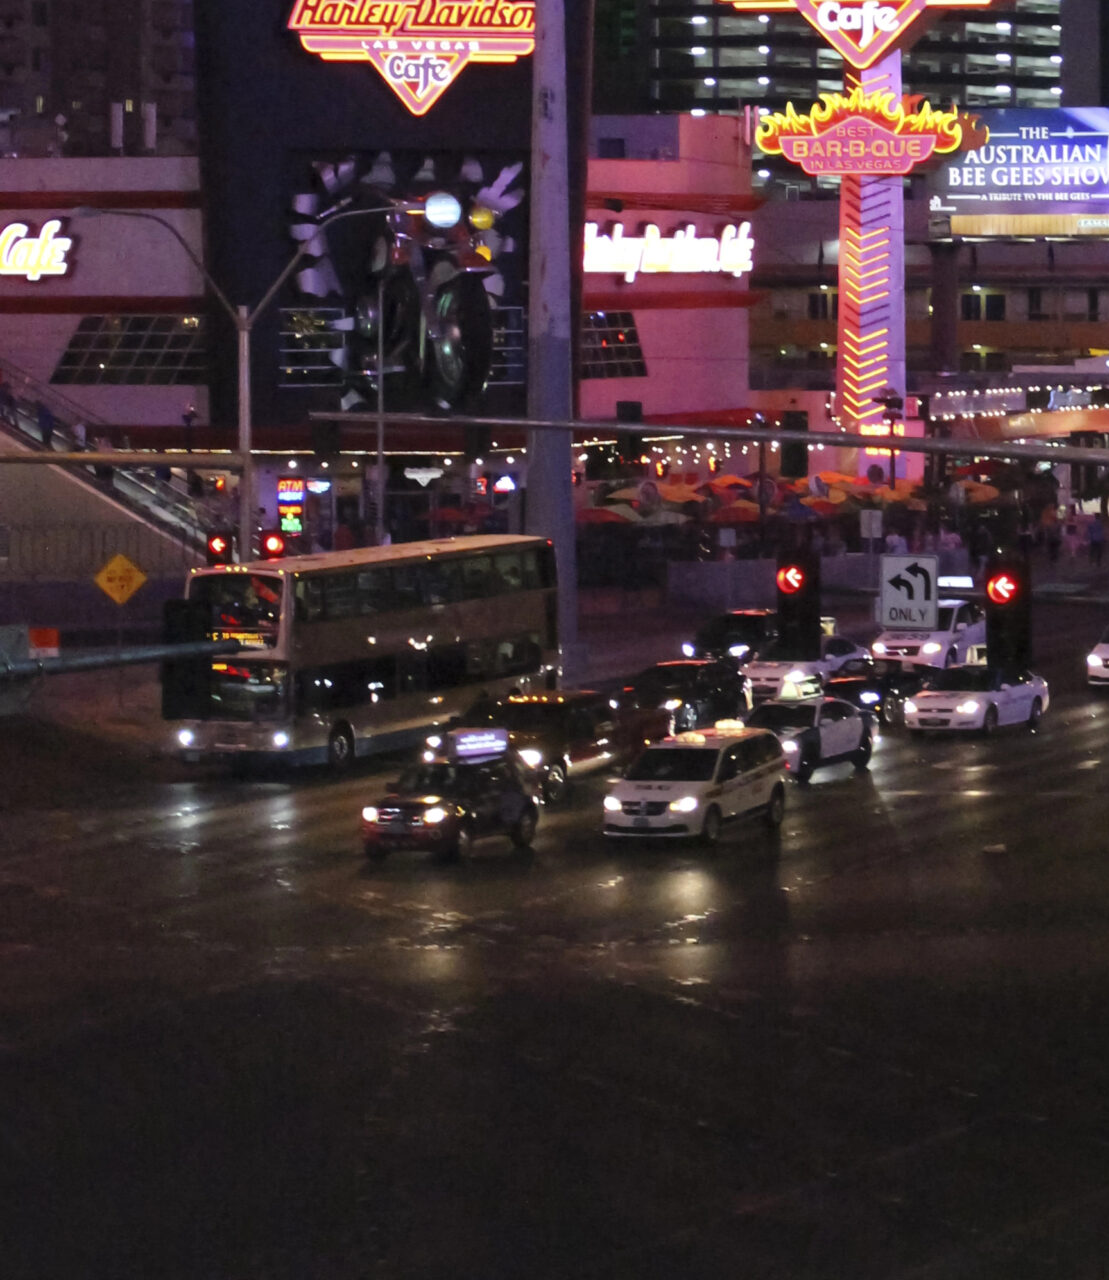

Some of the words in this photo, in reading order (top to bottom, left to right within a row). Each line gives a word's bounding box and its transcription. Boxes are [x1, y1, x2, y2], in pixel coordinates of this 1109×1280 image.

[360, 40, 398, 51] LAS
[411, 40, 480, 51] VEGAS
[836, 125, 877, 137] BEST
[1019, 126, 1049, 140] THE
[792, 139, 922, 158] BAR-B-QUE
[964, 144, 1101, 164] AUSTRALIAN
[809, 159, 823, 170] IN
[825, 159, 854, 170] LAS
[856, 159, 902, 170] VEGAS
[948, 167, 986, 187] BEE
[991, 167, 1047, 186] GEES
[980, 193, 988, 201] A
[988, 193, 1021, 201] TRIBUTE
[1023, 193, 1035, 201] TO
[1037, 193, 1053, 201] THE
[278, 479, 304, 492] ATM
[889, 607, 928, 622] ONLY
